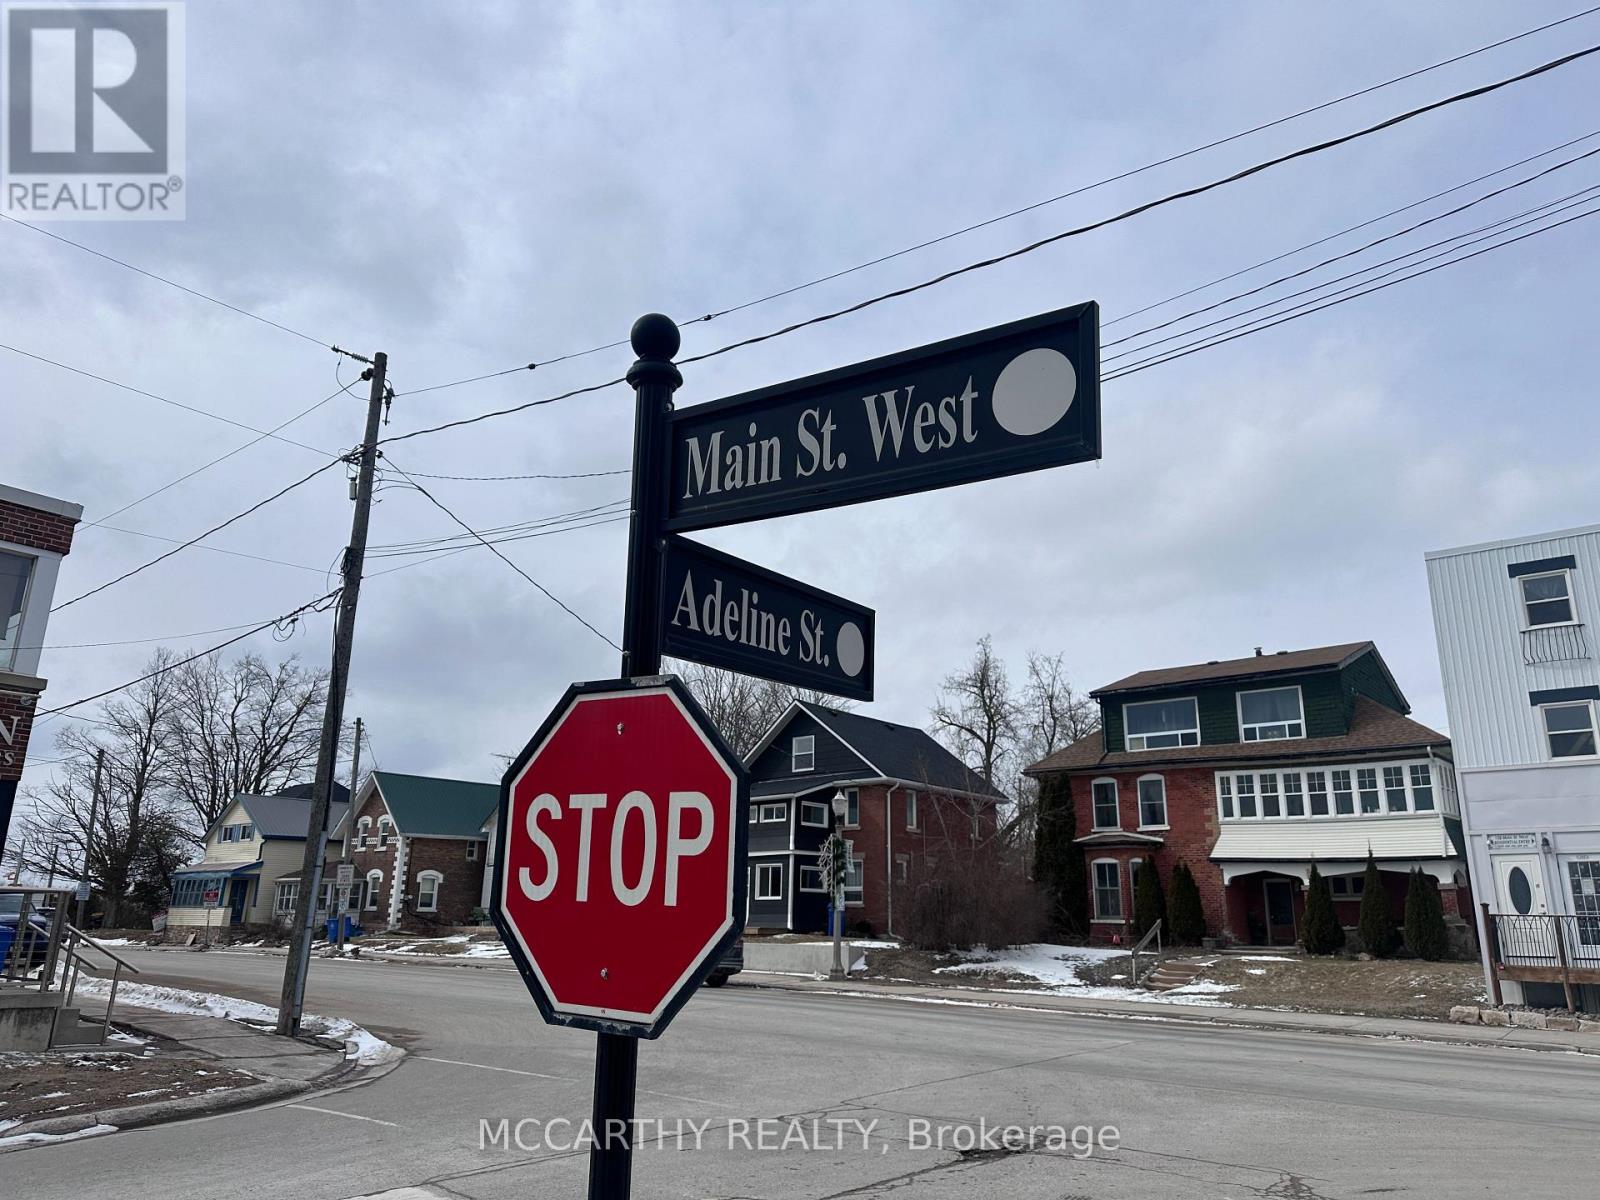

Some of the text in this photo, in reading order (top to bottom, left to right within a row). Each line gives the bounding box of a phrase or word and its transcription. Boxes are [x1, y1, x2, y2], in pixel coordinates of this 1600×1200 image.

[682, 374, 980, 500] Main St. West
[670, 568, 830, 668] Adeline St.
[518, 790, 715, 907] STOP
